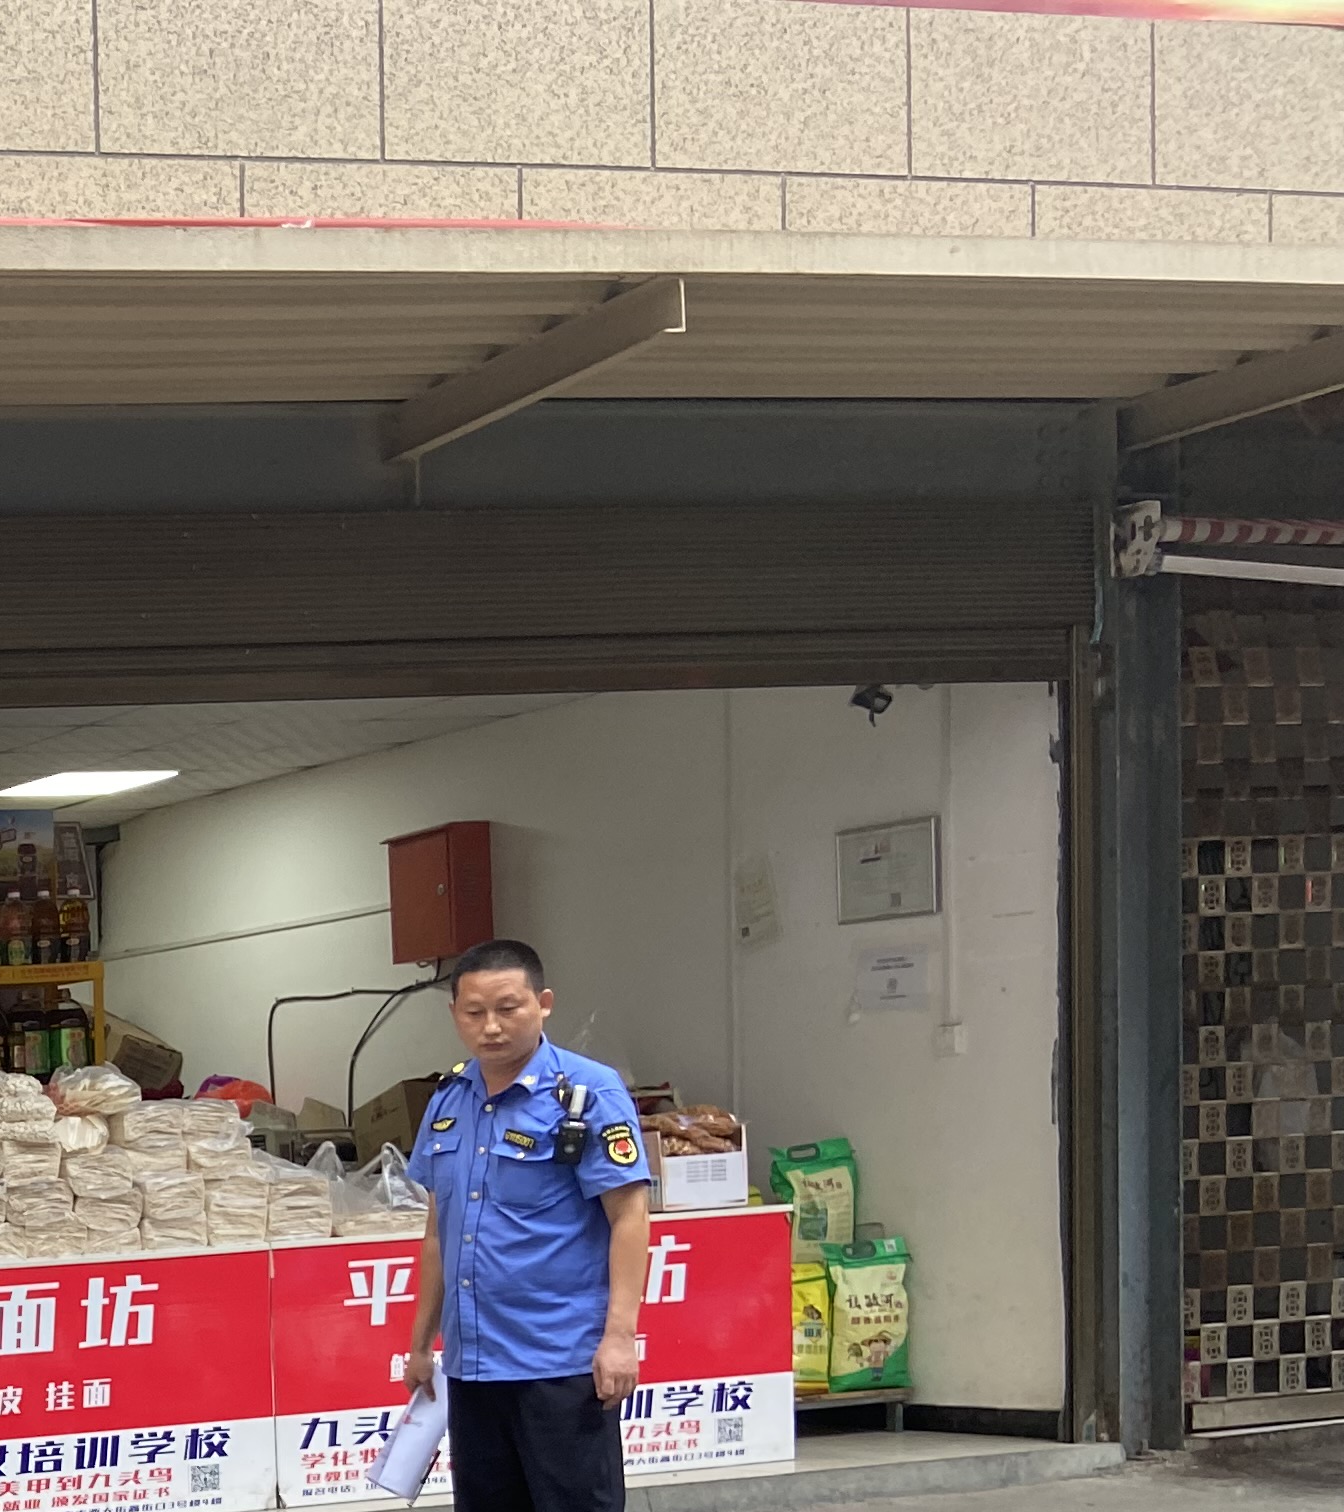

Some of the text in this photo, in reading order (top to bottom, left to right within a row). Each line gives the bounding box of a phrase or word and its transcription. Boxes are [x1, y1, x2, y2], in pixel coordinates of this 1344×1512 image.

[343, 1255, 416, 1326] 平
[45, 1377, 112, 1412] 挂面
[625, 1419, 701, 1440] 九头鸟
[305, 1469, 362, 1485] 包教包
